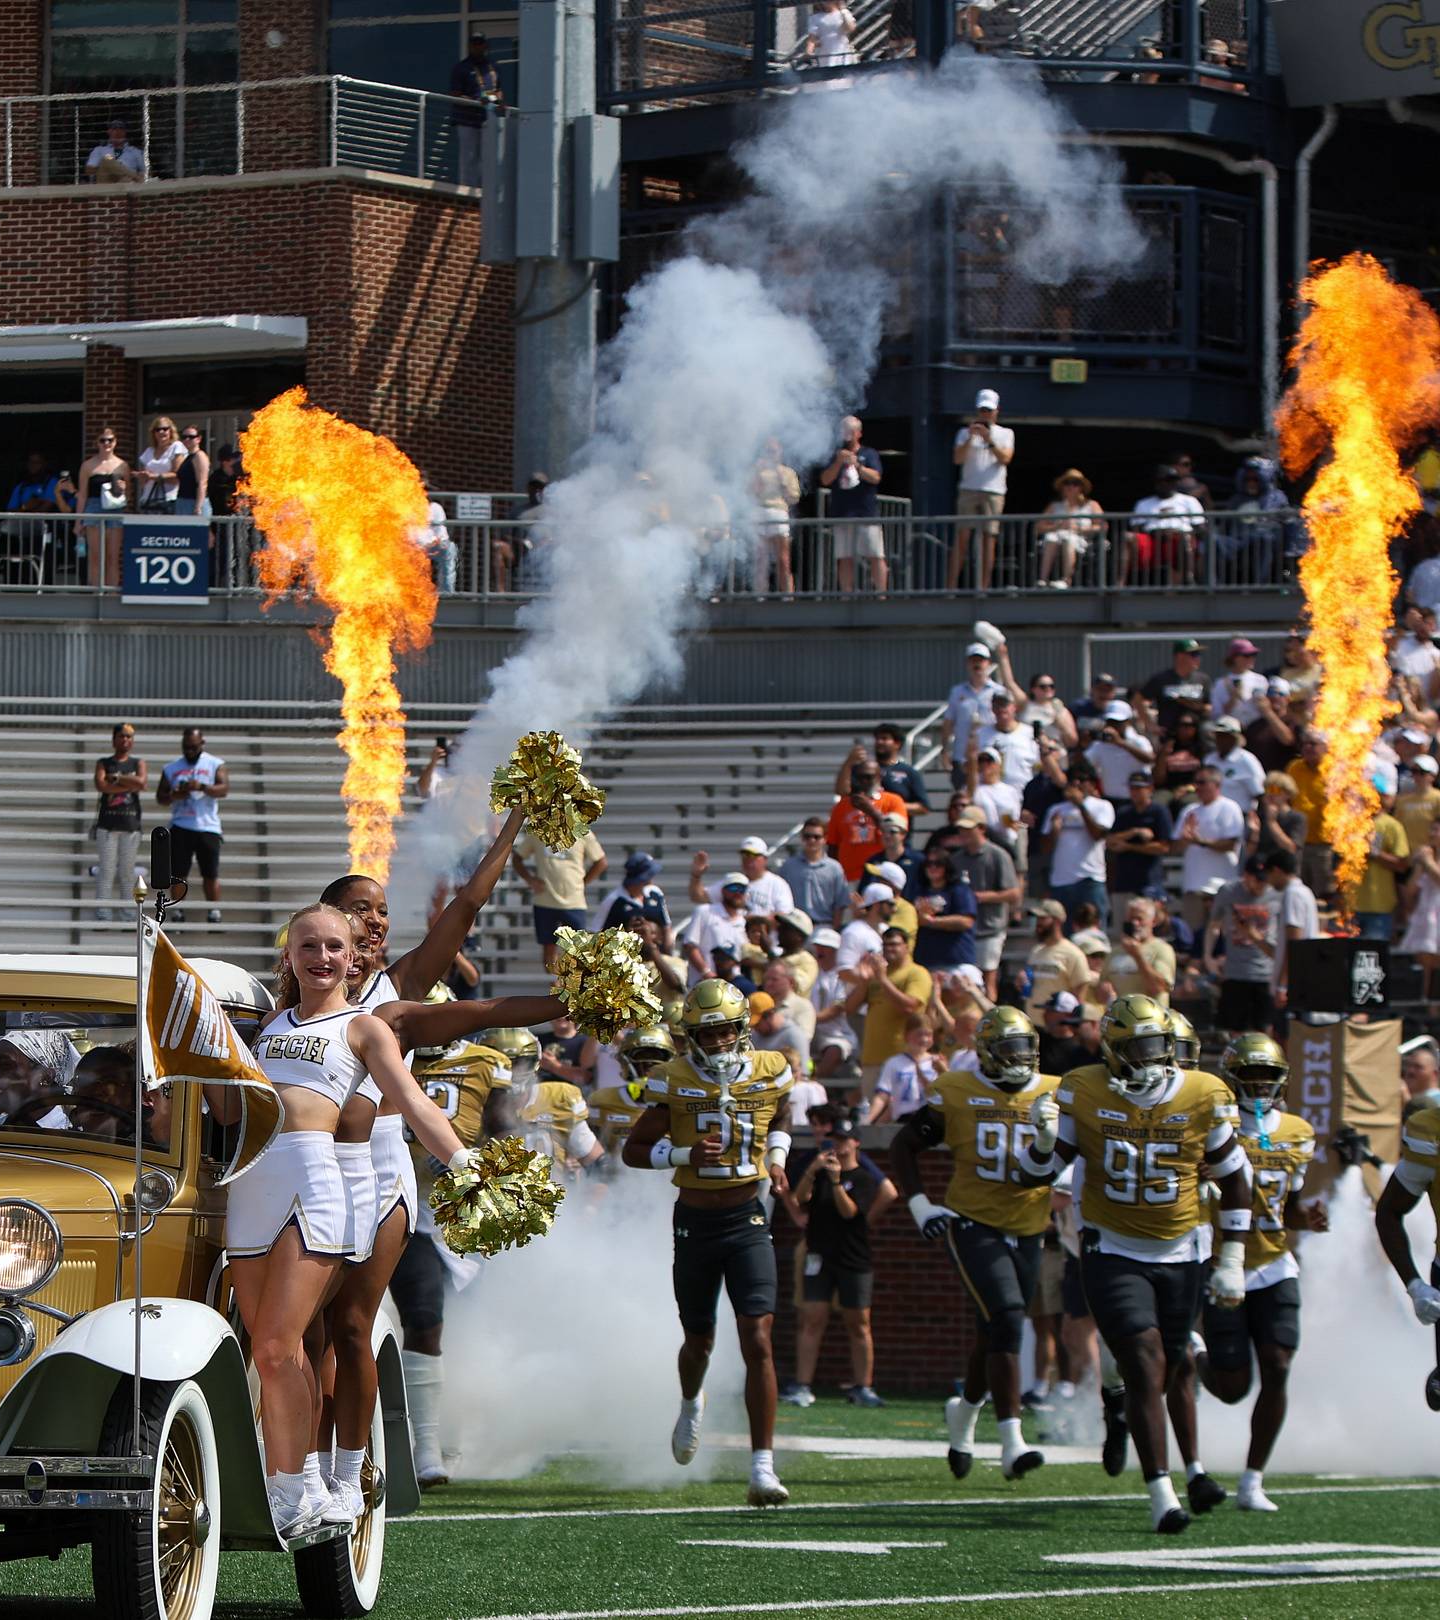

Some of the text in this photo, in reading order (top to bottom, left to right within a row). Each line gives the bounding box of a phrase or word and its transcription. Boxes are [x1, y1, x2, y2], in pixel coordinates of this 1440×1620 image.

[141, 536, 191, 547] SECTION
[135, 556, 196, 585] 120
[160, 968, 196, 1050] TO
[189, 985, 230, 1059] HELL
[696, 1111, 759, 1179] 21
[1153, 1129, 1185, 1140] TECH
[1103, 1138, 1181, 1206] 95
